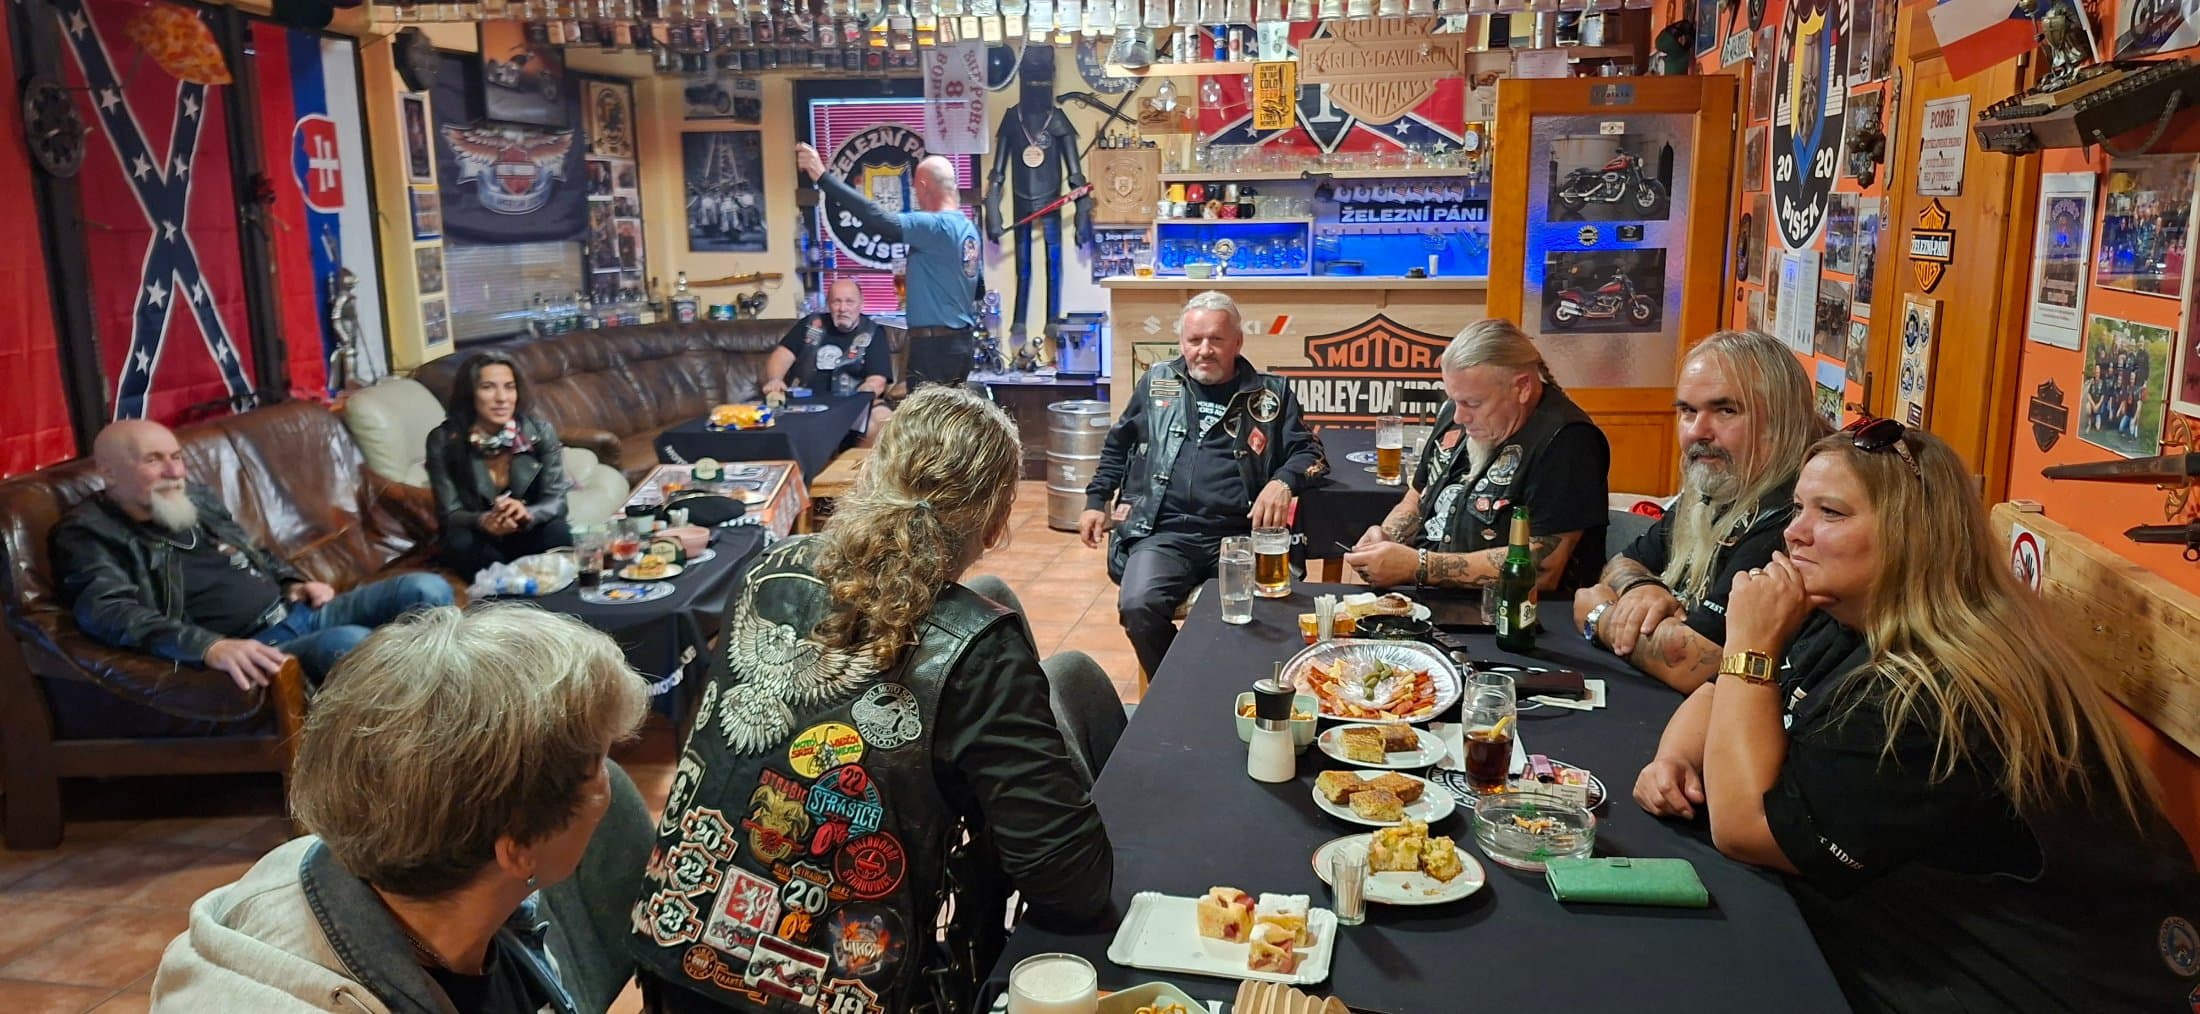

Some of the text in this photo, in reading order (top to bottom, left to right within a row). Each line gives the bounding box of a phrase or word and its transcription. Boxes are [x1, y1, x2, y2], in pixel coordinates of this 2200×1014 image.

[1340, 79, 1420, 115] COMPANY
[1776, 147, 1834, 182] 20 20
[1341, 203, 1484, 223] ŽELEZNÍ PÁNI
[1327, 329, 1431, 368] MOTOR
[843, 767, 863, 793] 22
[689, 820, 721, 850] 20
[786, 879, 824, 913] 20
